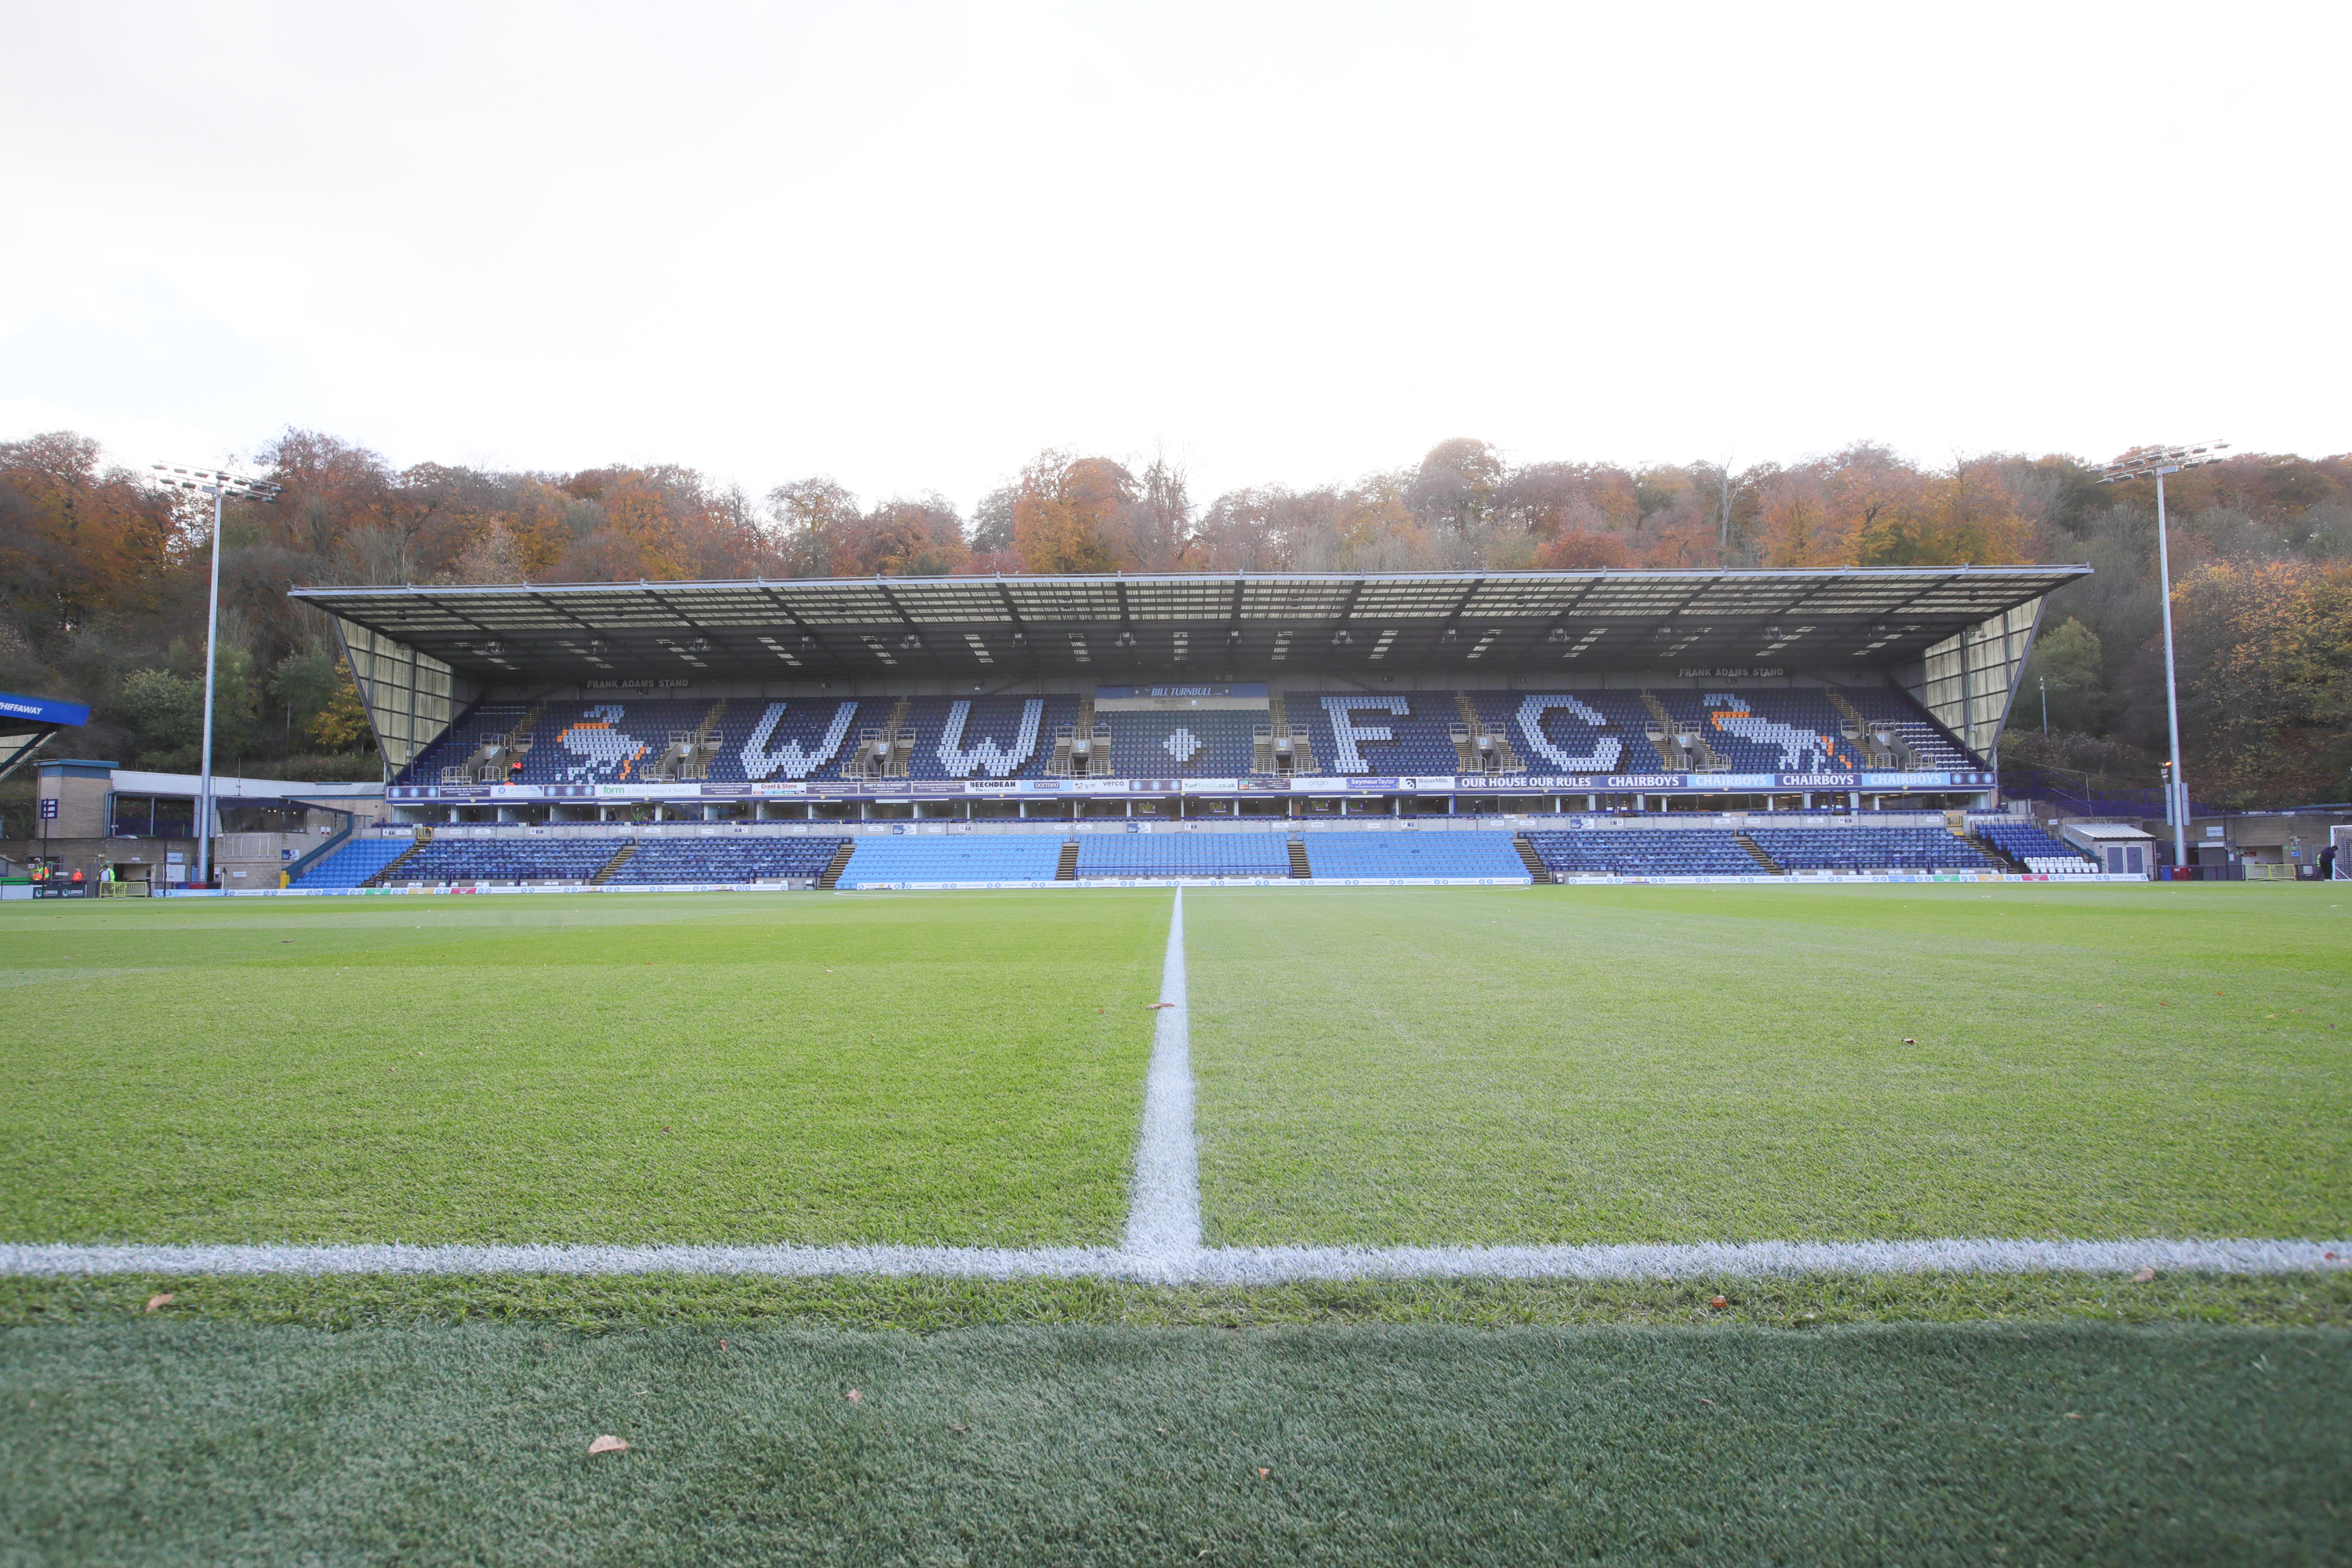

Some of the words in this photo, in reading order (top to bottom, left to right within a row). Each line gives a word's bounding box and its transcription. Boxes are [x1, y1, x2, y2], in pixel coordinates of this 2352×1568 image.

[1715, 668, 1748, 677] ADAMS
[1752, 668, 1784, 677] STAND
[659, 679, 689, 688] STAND
[1151, 688, 1169, 696] BILL
[1171, 687, 1212, 696] TURNBULL
[0, 702, 43, 715] HIFFAWAY
[1320, 695, 1410, 774] F
[1515, 695, 1622, 772] C
[1461, 778, 1487, 787] OUR
[1488, 777, 1527, 787] HOUSE
[1529, 777, 1554, 786] OUR
[1556, 777, 1591, 786] RULES
[1608, 776, 1679, 786] CHAIRBOYS
[1695, 775, 1766, 786] CHAIRBOYS
[1782, 775, 1854, 786] CHAIRBOYS
[1870, 775, 1941, 785] CHAIRBOYS
